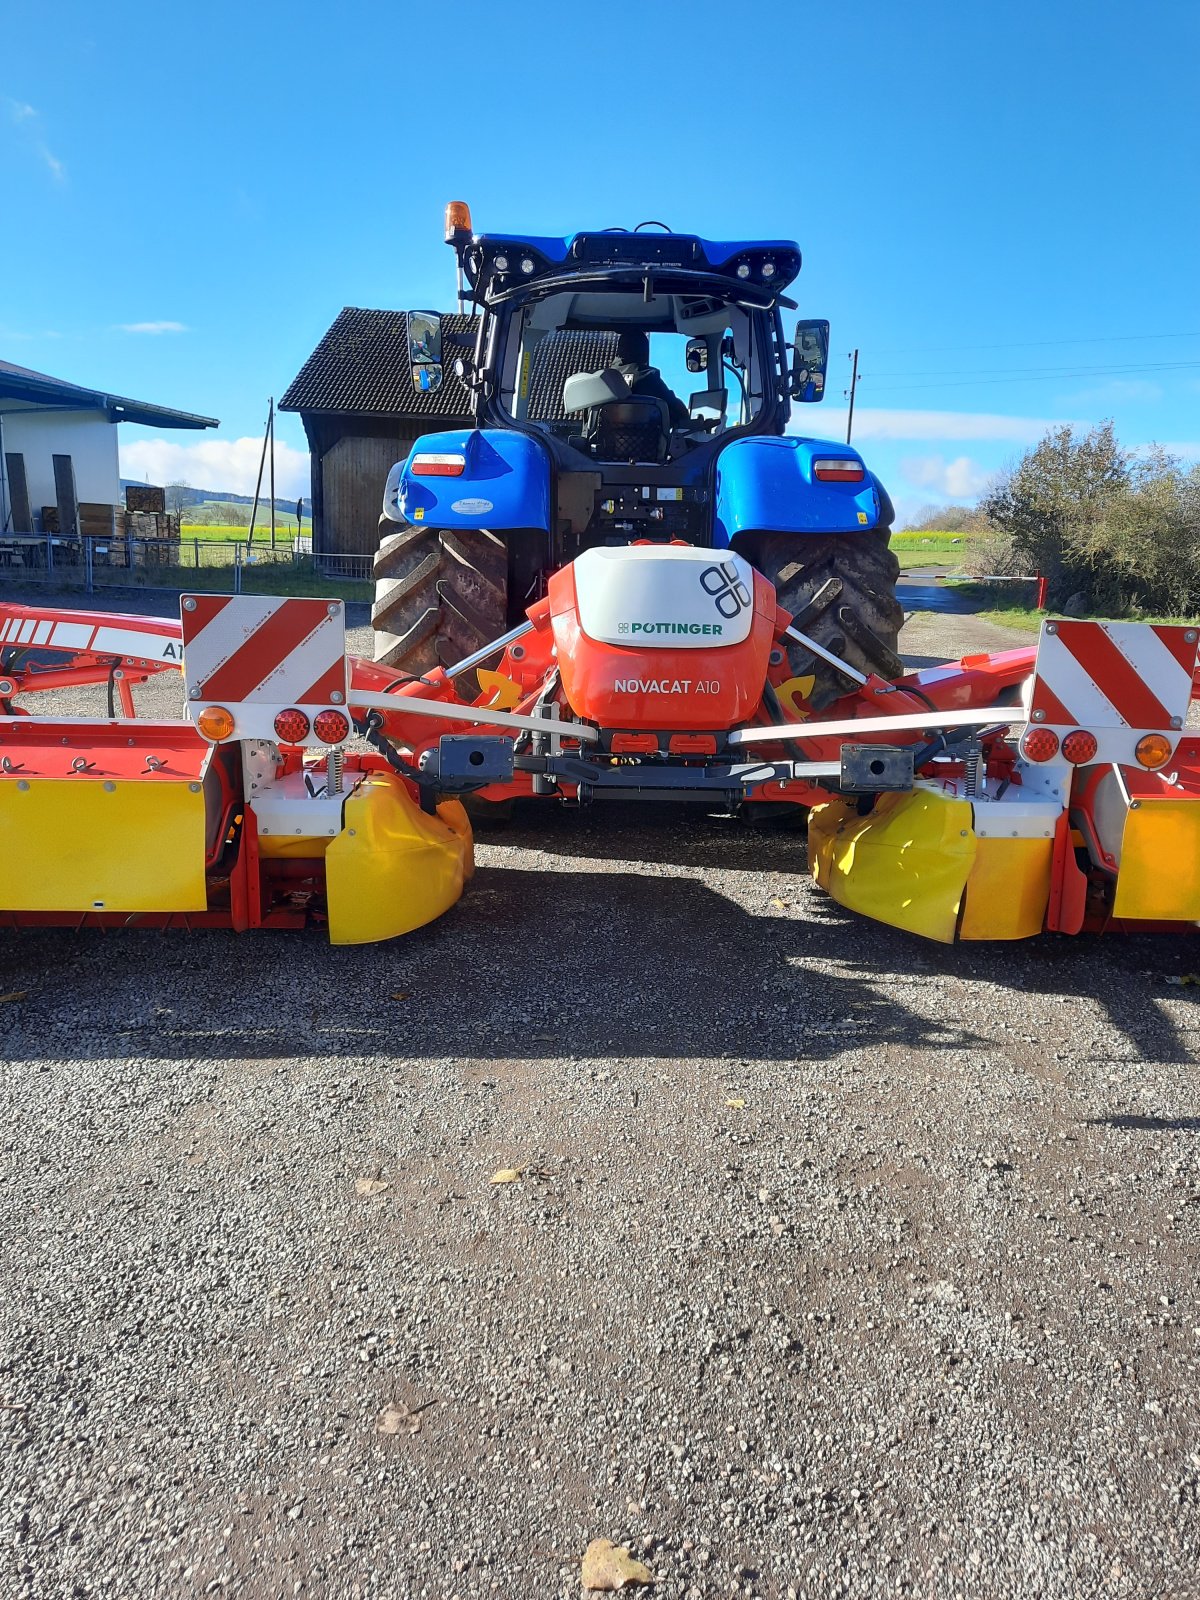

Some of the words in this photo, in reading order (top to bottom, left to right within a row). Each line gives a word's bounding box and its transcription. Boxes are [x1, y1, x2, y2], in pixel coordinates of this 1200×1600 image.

[631, 622, 723, 635] PÖTTINGER
[614, 679, 692, 694] NOVACAT
[695, 680, 720, 694] A10
